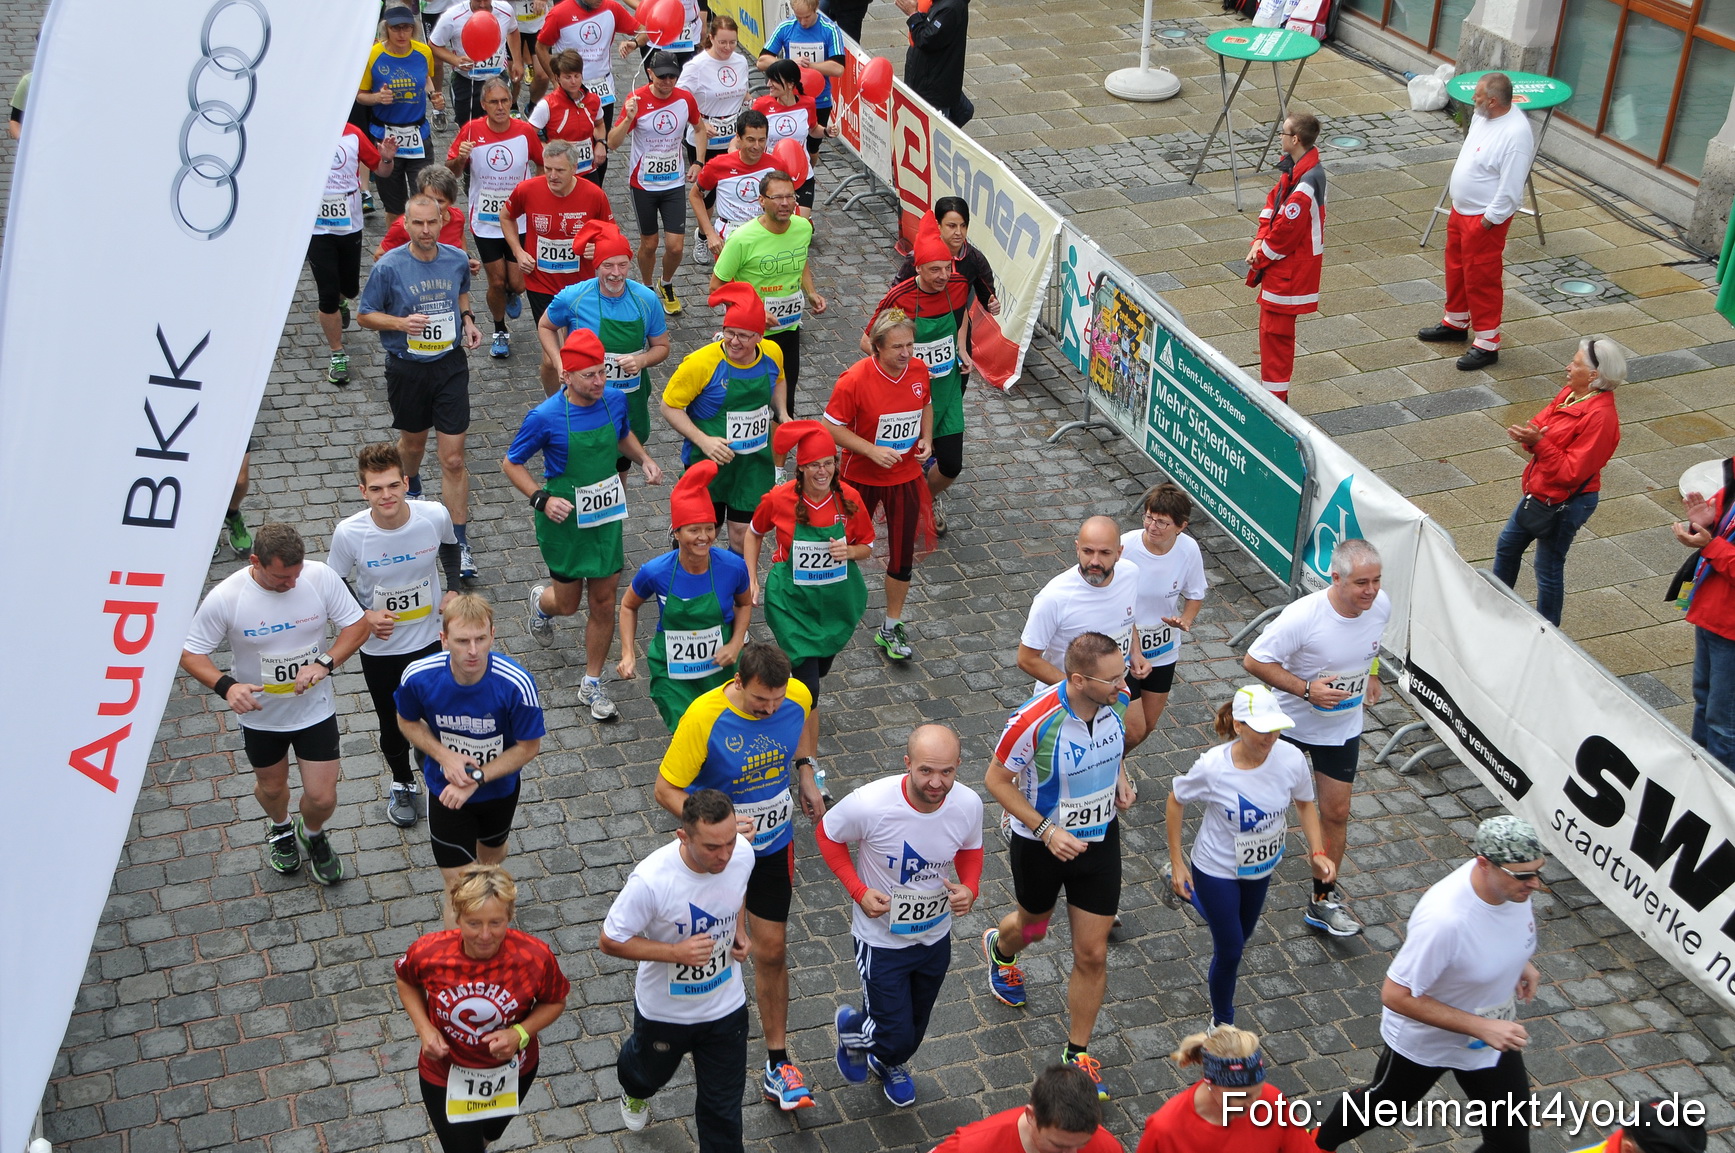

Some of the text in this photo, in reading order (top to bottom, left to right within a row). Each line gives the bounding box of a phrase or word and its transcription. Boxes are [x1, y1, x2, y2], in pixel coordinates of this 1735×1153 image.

[648, 159, 677, 174] 2858
[318, 202, 347, 218] 863
[541, 246, 576, 261] 2043
[760, 285, 783, 293] MERZ
[769, 301, 802, 318] 2245
[422, 324, 442, 340] 66
[604, 363, 638, 379] 21
[1178, 357, 1246, 425] Event-Leit-Systeme
[121, 321, 212, 530] BKK
[732, 418, 767, 439] 2789
[881, 421, 918, 440] 2087
[1155, 378, 1247, 475] Mehr Sicherheit
[1153, 404, 1228, 488] für Ihr Event!
[581, 486, 619, 512] 2067
[1150, 440, 1260, 550] Miet & Service Line: 09181 6352
[366, 552, 416, 568] RÖDL
[808, 570, 835, 581] Brigitte
[386, 591, 421, 612] 631
[243, 620, 297, 637] RÖDL
[666, 634, 686, 642] PARTL
[261, 650, 312, 664] PARTL Neumarkt
[672, 638, 720, 662] 2407
[683, 662, 710, 673] Carolin
[68, 570, 166, 795] Audi
[435, 713, 497, 731] HUBER
[1408, 673, 1518, 789] istungen, die verbinden
[1089, 732, 1119, 752] PLAST
[1065, 799, 1113, 828] 2914
[754, 829, 779, 844] homas
[1076, 827, 1103, 838] Martin
[909, 873, 940, 884] Team
[1551, 807, 1703, 956] stadtwerke
[893, 889, 948, 901] PARTL Neumarkt
[897, 896, 950, 922] 2827
[675, 949, 727, 982] 2831
[684, 976, 723, 995] Christian
[438, 981, 519, 1015] FINISHER
[464, 1075, 506, 1097] 184
